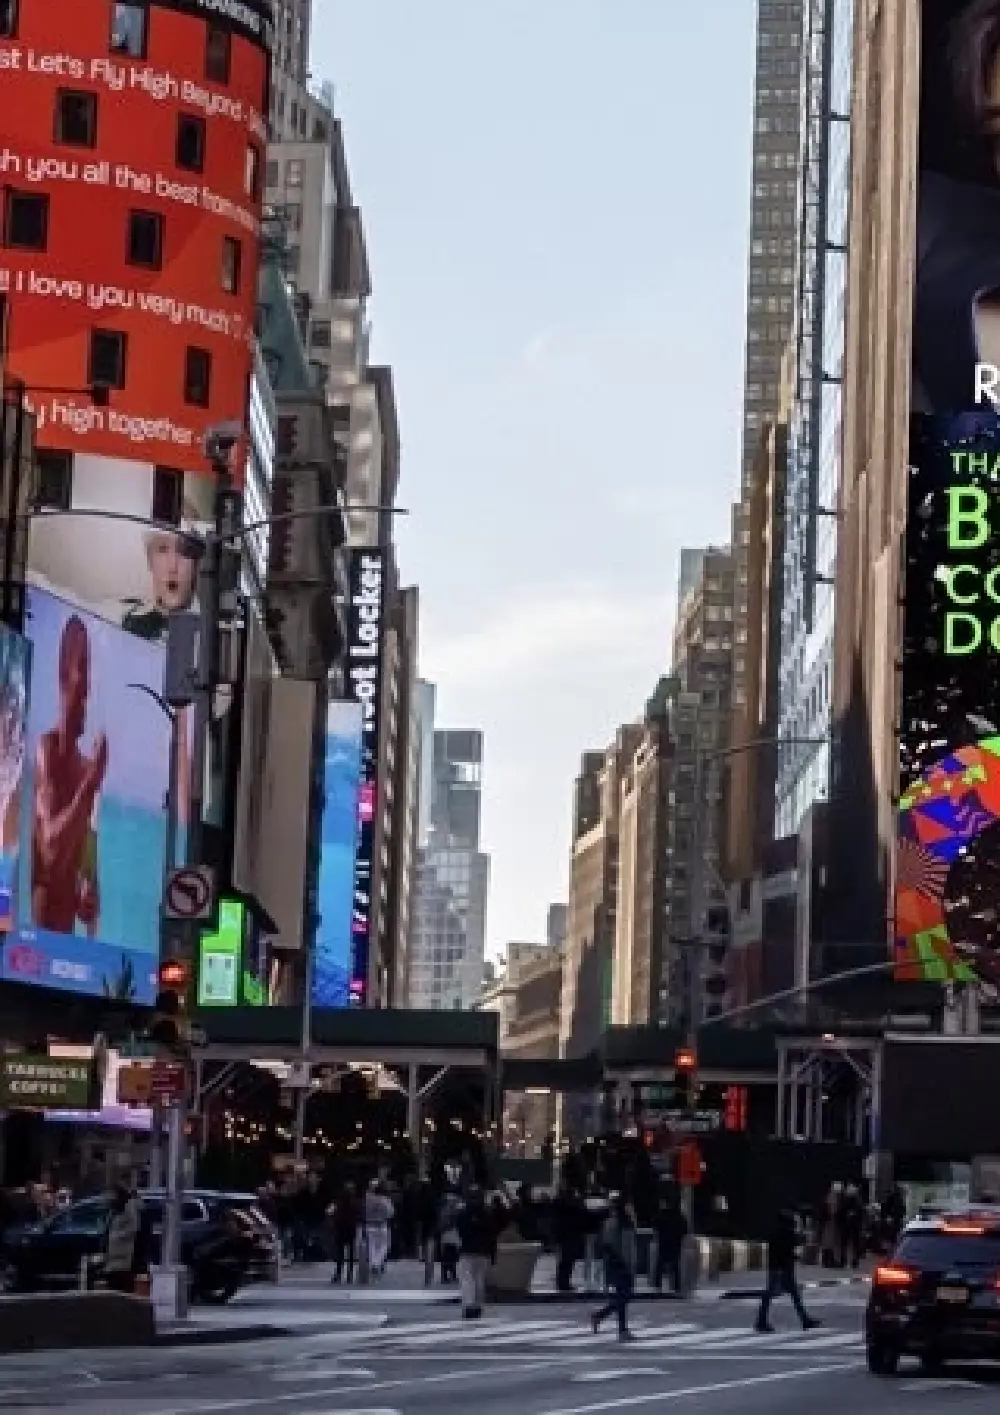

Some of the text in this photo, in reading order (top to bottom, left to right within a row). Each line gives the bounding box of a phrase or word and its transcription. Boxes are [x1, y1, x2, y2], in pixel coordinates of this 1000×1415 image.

[27, 49, 84, 79] Let's
[90, 57, 126, 91] Fly
[130, 67, 179, 100] High
[27, 158, 76, 182] you
[82, 162, 110, 185] all
[115, 165, 151, 194] the
[155, 174, 199, 206] best
[30, 271, 82, 299] love
[87, 283, 134, 310] you
[137, 292, 182, 325] very
[186, 304, 229, 335] much
[52, 398, 104, 434] high
[108, 411, 192, 447] together
[350, 555, 382, 656] Locker
